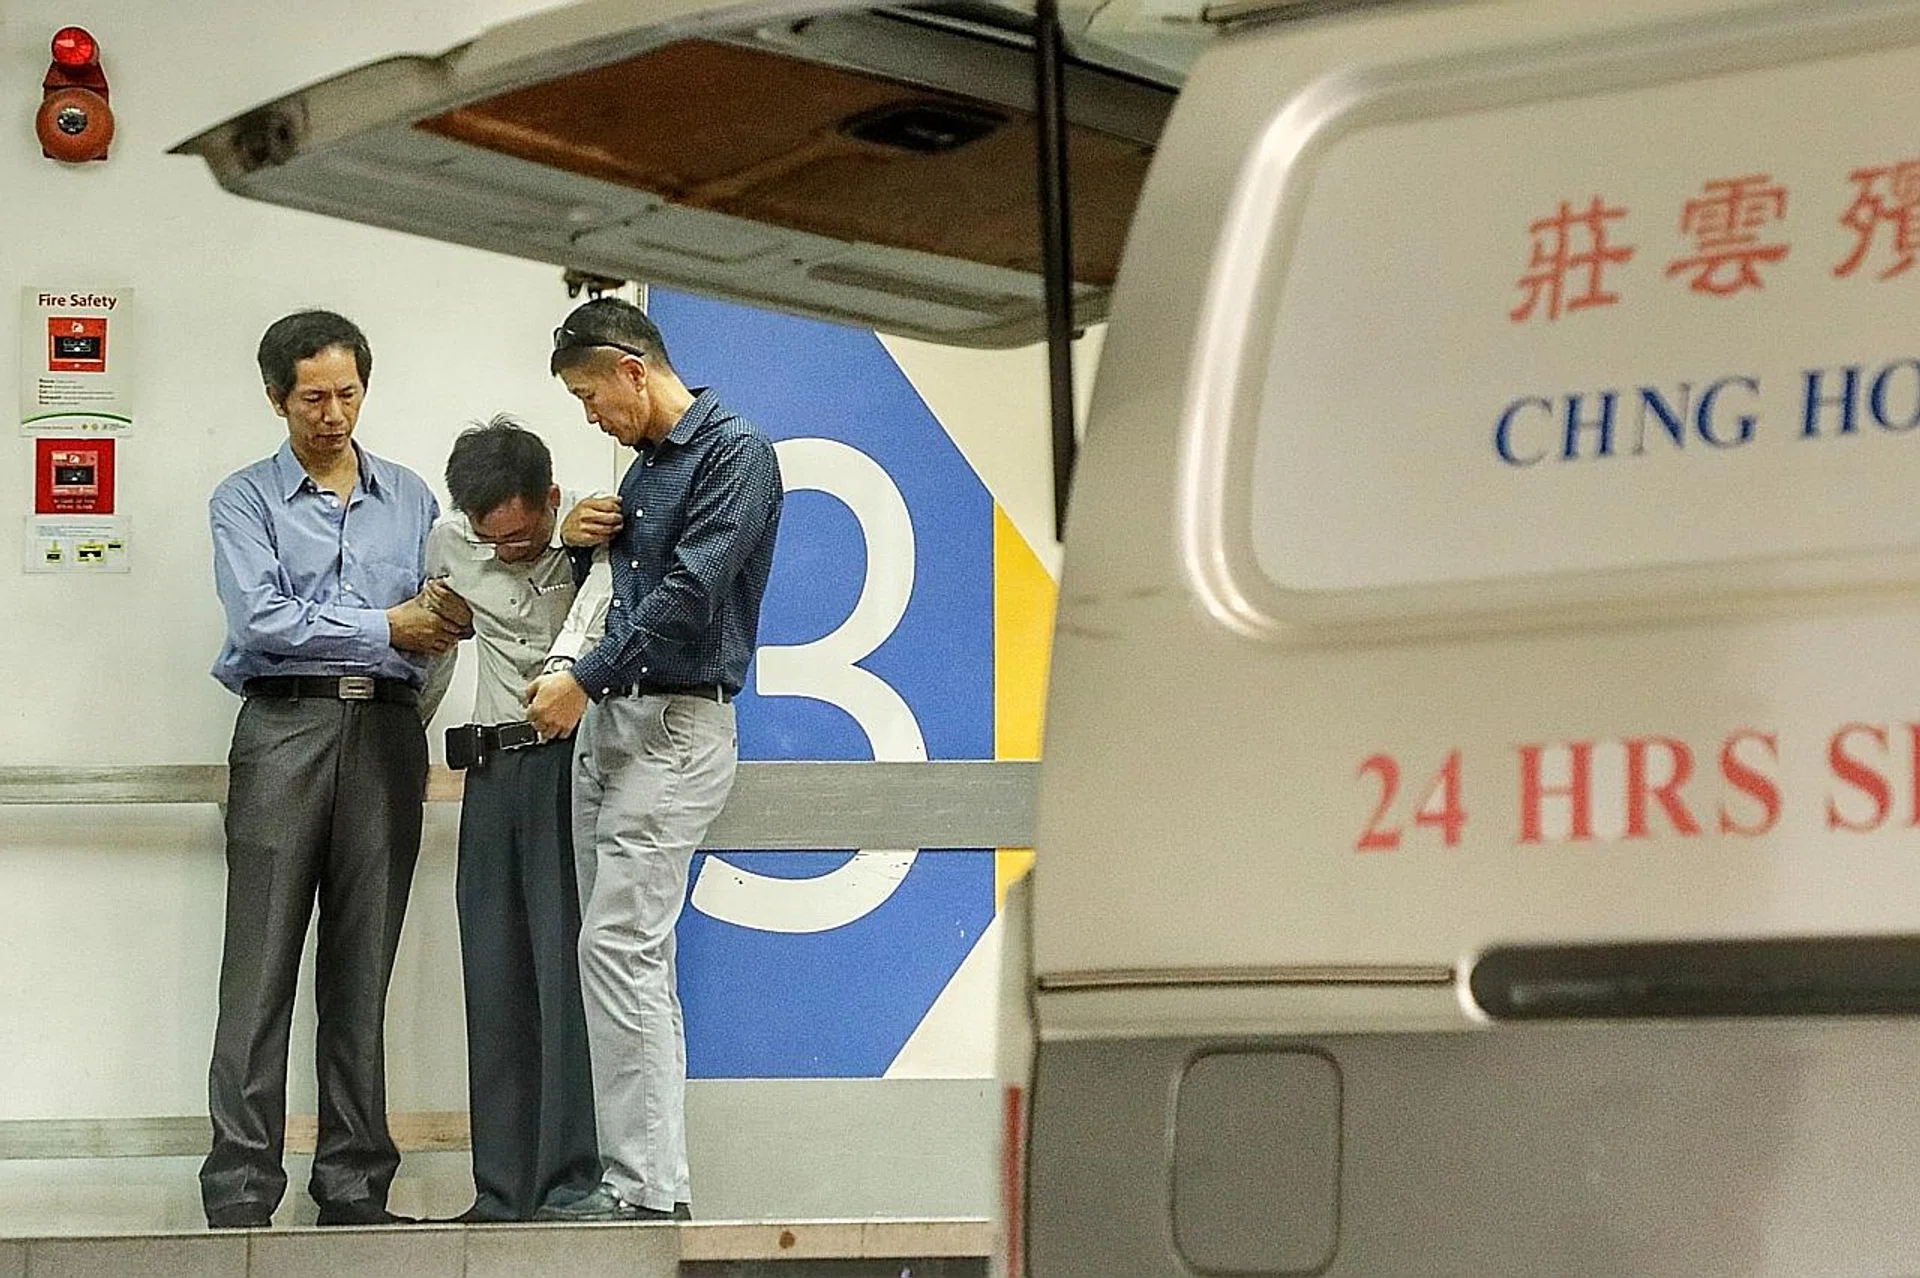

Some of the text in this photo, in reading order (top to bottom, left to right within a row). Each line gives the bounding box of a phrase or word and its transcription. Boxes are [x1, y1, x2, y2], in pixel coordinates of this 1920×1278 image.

[38, 293, 117, 310] Fire Safety
[1494, 359, 1920, 467] CHNG HO
[690, 437, 928, 934] 3
[1354, 721, 1920, 852] 24 HRS S
